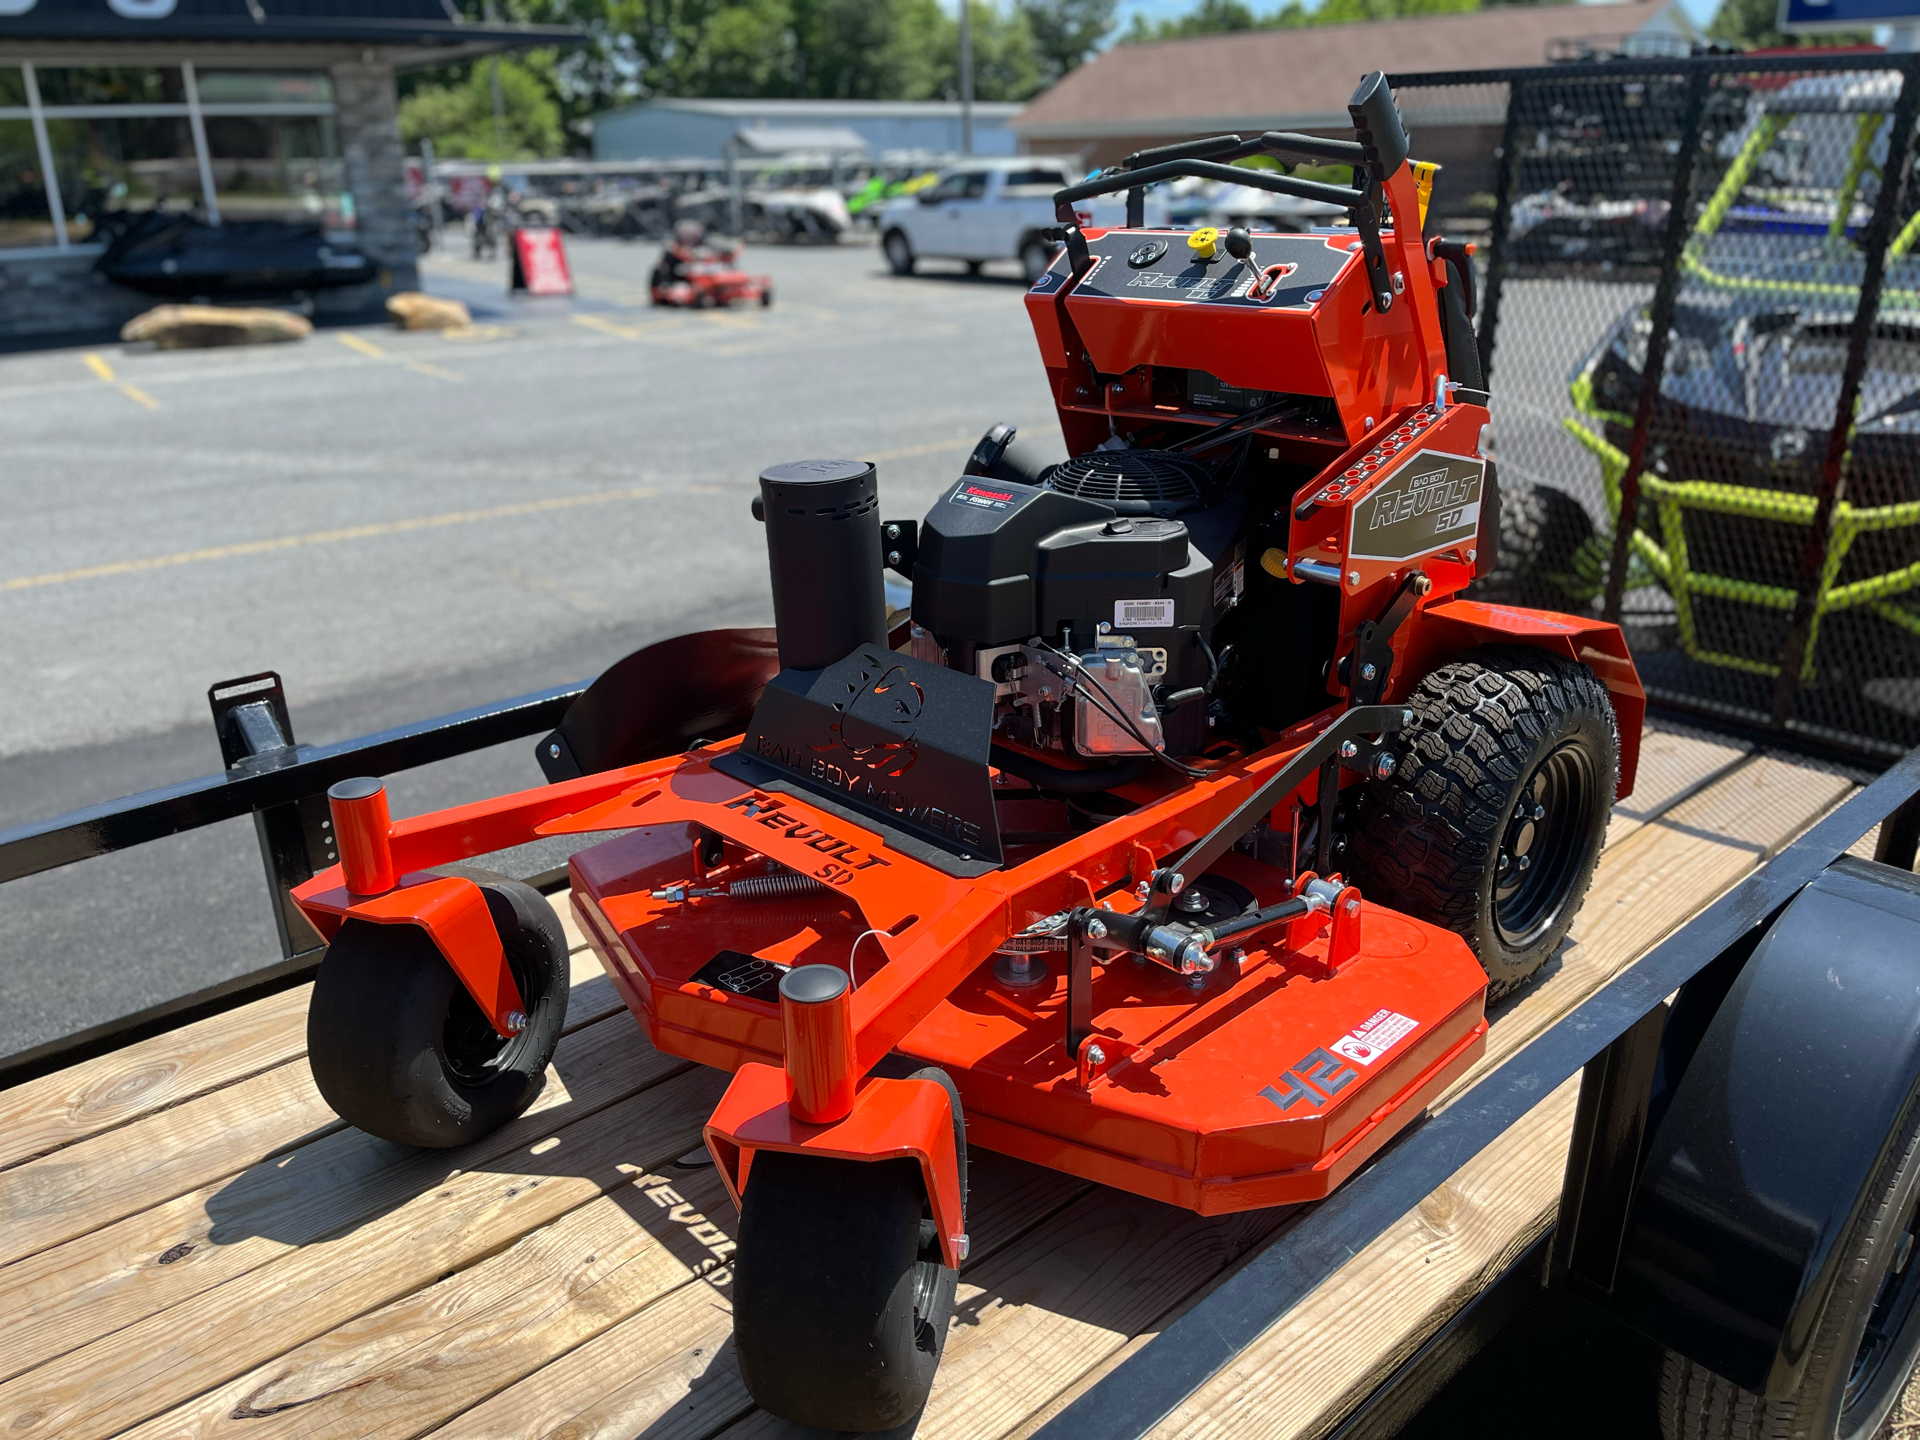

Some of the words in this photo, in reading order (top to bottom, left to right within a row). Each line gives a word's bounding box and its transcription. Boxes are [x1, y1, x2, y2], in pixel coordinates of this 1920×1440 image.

[966, 486, 1013, 501] Kawasaki
[1414, 476, 1428, 487] BAD
[1430, 472, 1444, 483] BOY
[1369, 475, 1478, 530] REVOLT
[757, 735, 802, 770] BAD
[811, 758, 860, 791] BOY
[866, 781, 981, 846] MOWERS
[724, 791, 892, 871] REVOLT
[813, 864, 854, 886] SD
[1360, 1009, 1392, 1031] DANGER
[1256, 1046, 1358, 1111] 42
